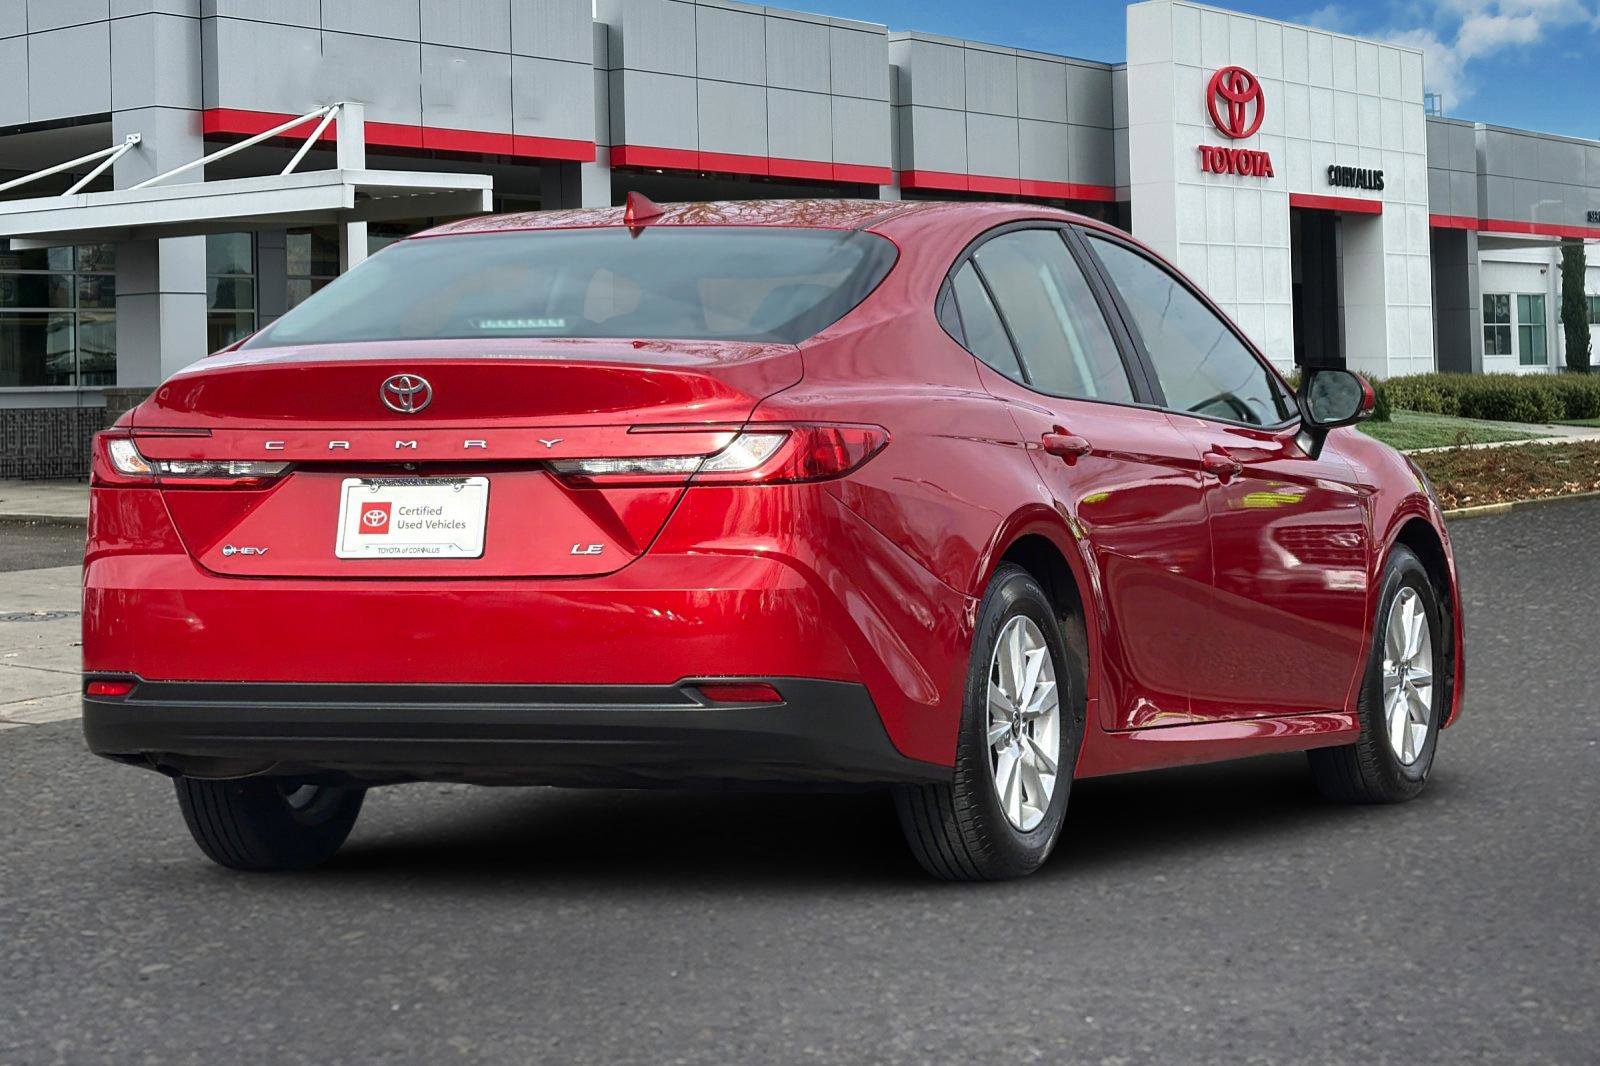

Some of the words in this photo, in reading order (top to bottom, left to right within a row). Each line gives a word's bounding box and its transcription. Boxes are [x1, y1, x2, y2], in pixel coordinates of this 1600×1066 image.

[1199, 145, 1274, 178] TOYOTA
[1328, 165, 1384, 190] CORVALLIS
[265, 438, 565, 450] CAMRY
[398, 506, 442, 516] Certified
[397, 520, 422, 529] Used
[425, 519, 466, 529] Vehicles
[233, 546, 269, 555] HEV
[571, 544, 604, 555] LE
